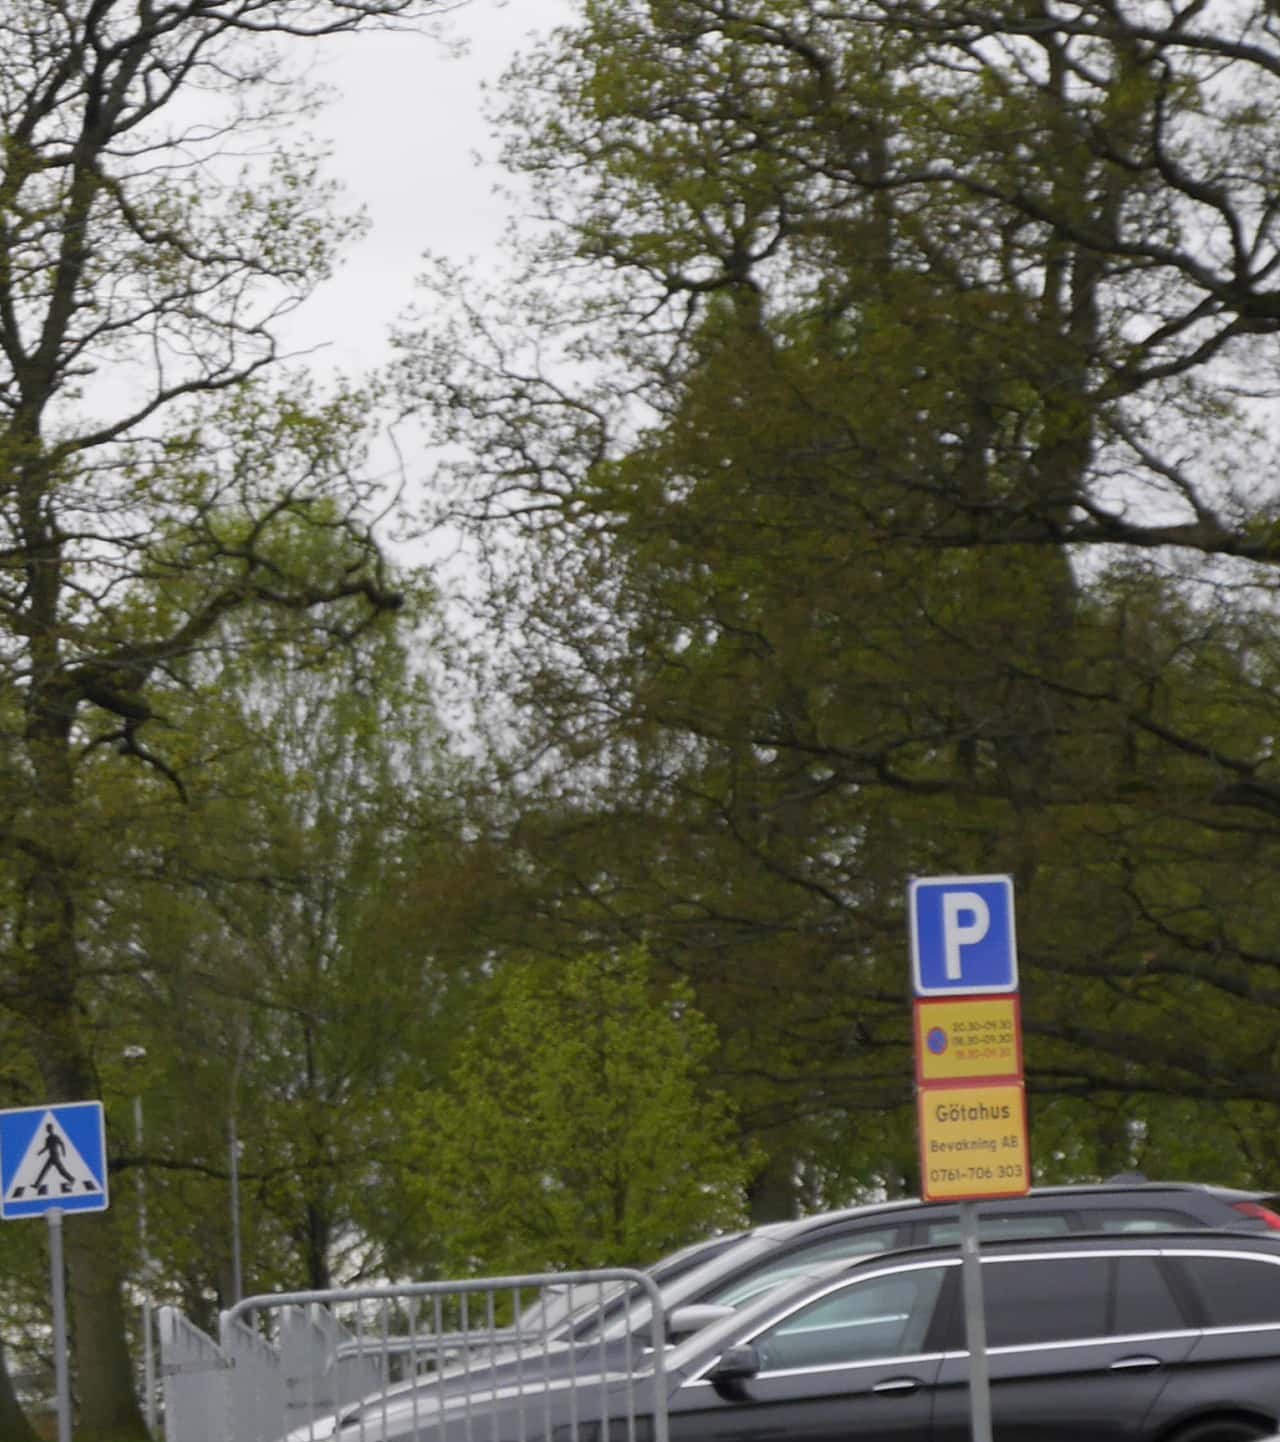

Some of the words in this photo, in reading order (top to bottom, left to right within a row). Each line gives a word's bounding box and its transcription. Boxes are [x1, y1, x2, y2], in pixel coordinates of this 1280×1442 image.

[942, 891, 991, 981] P
[935, 1102, 1010, 1122] Götahus
[930, 1138, 997, 1153] Bevakning
[1002, 1135, 1018, 1148] AB
[930, 1166, 992, 1183] 0761-706
[998, 1164, 1023, 1178] 303
